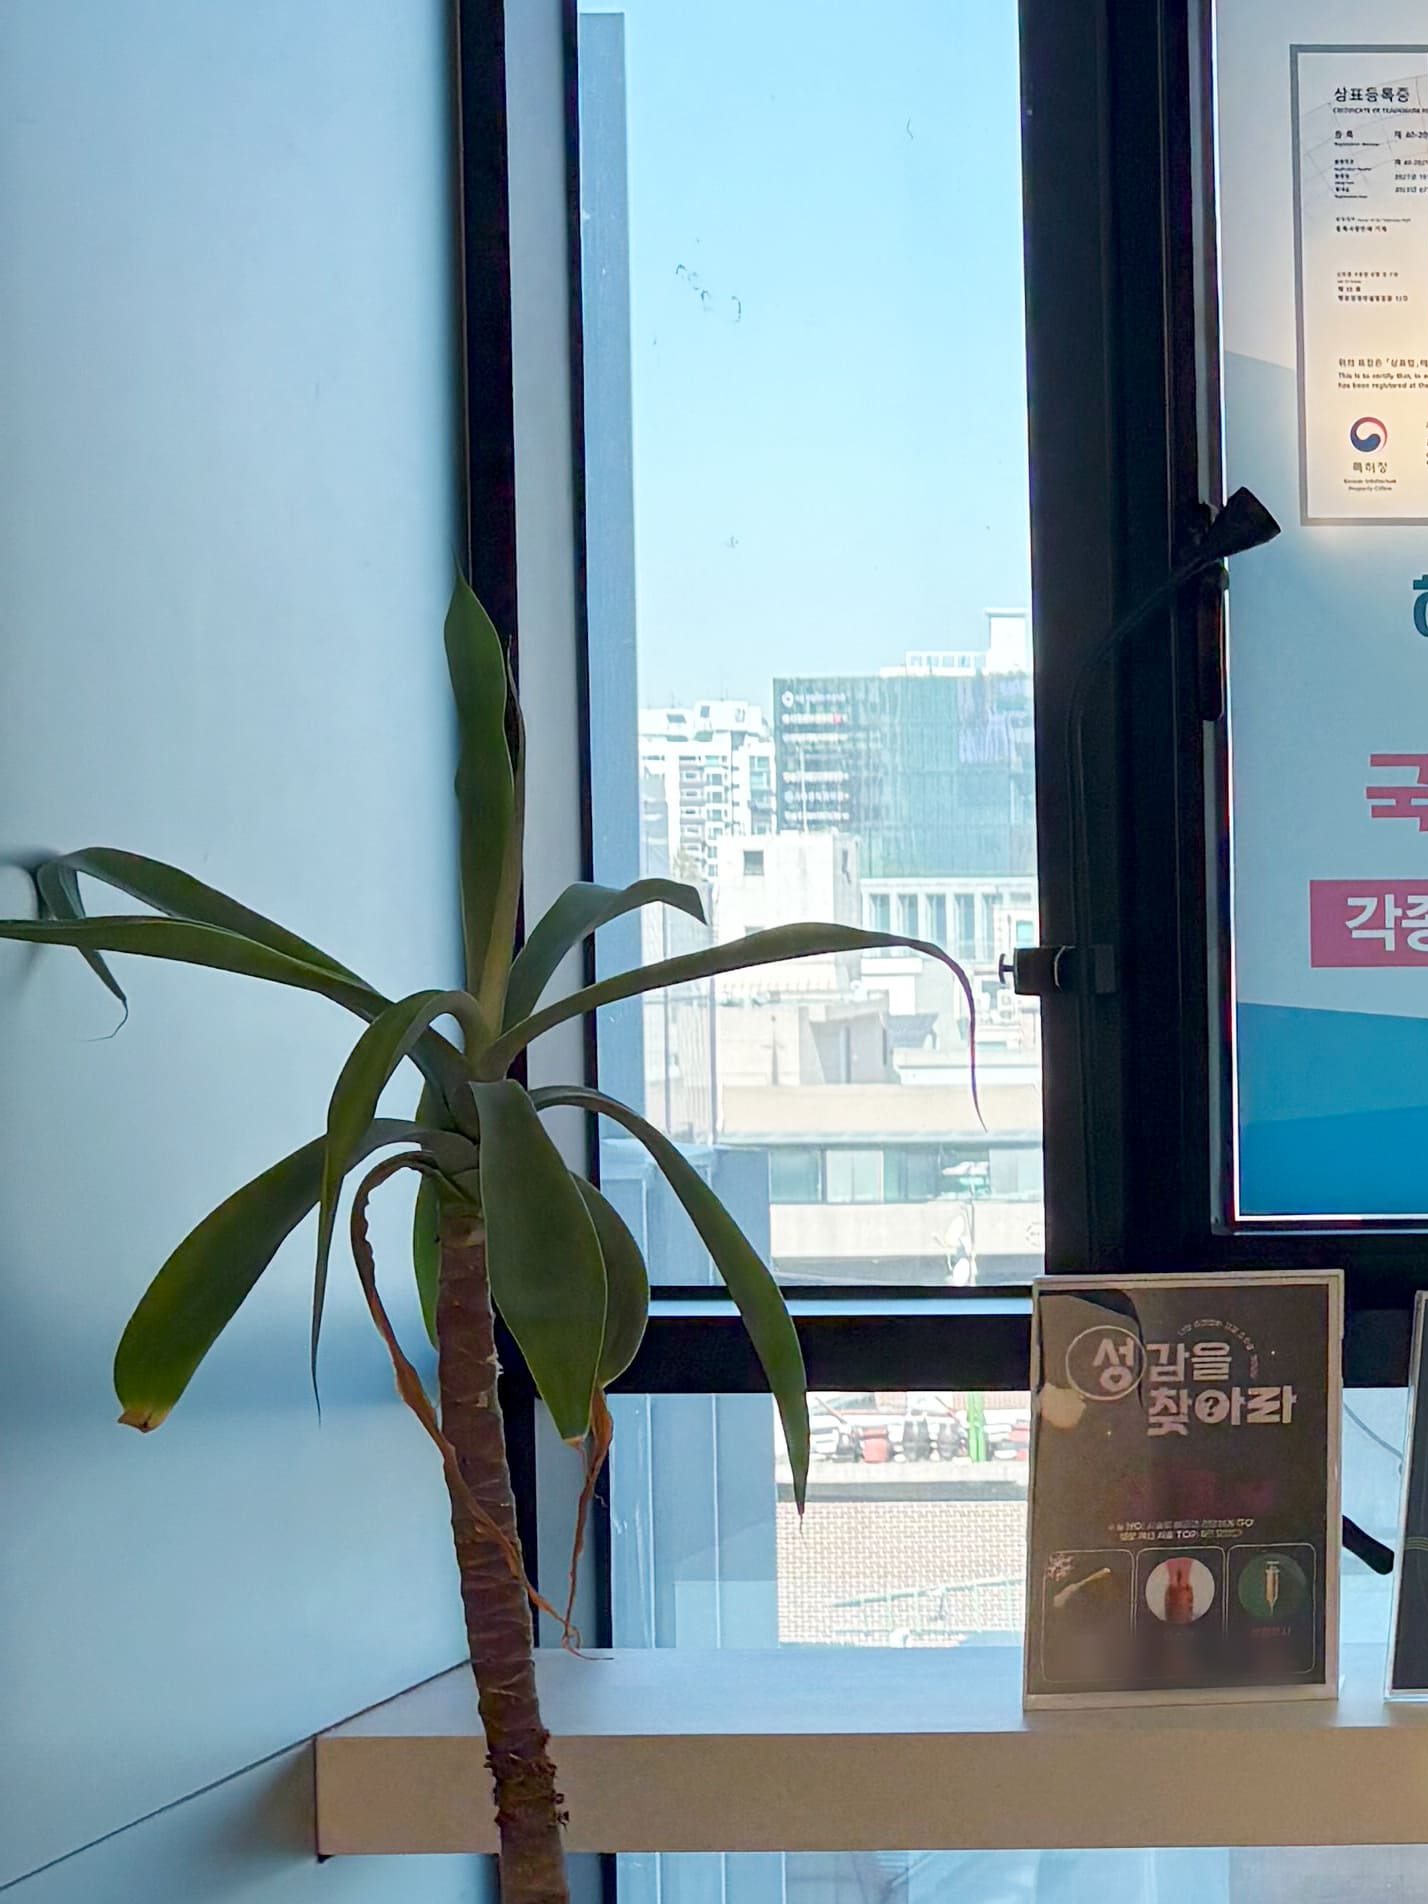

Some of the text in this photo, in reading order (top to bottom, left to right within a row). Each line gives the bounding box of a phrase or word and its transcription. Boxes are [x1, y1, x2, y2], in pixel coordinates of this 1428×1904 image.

[1334, 86, 1410, 103] 상표등록증
[1353, 461, 1389, 474] 특허청
[1091, 1336, 1232, 1393] 성감을
